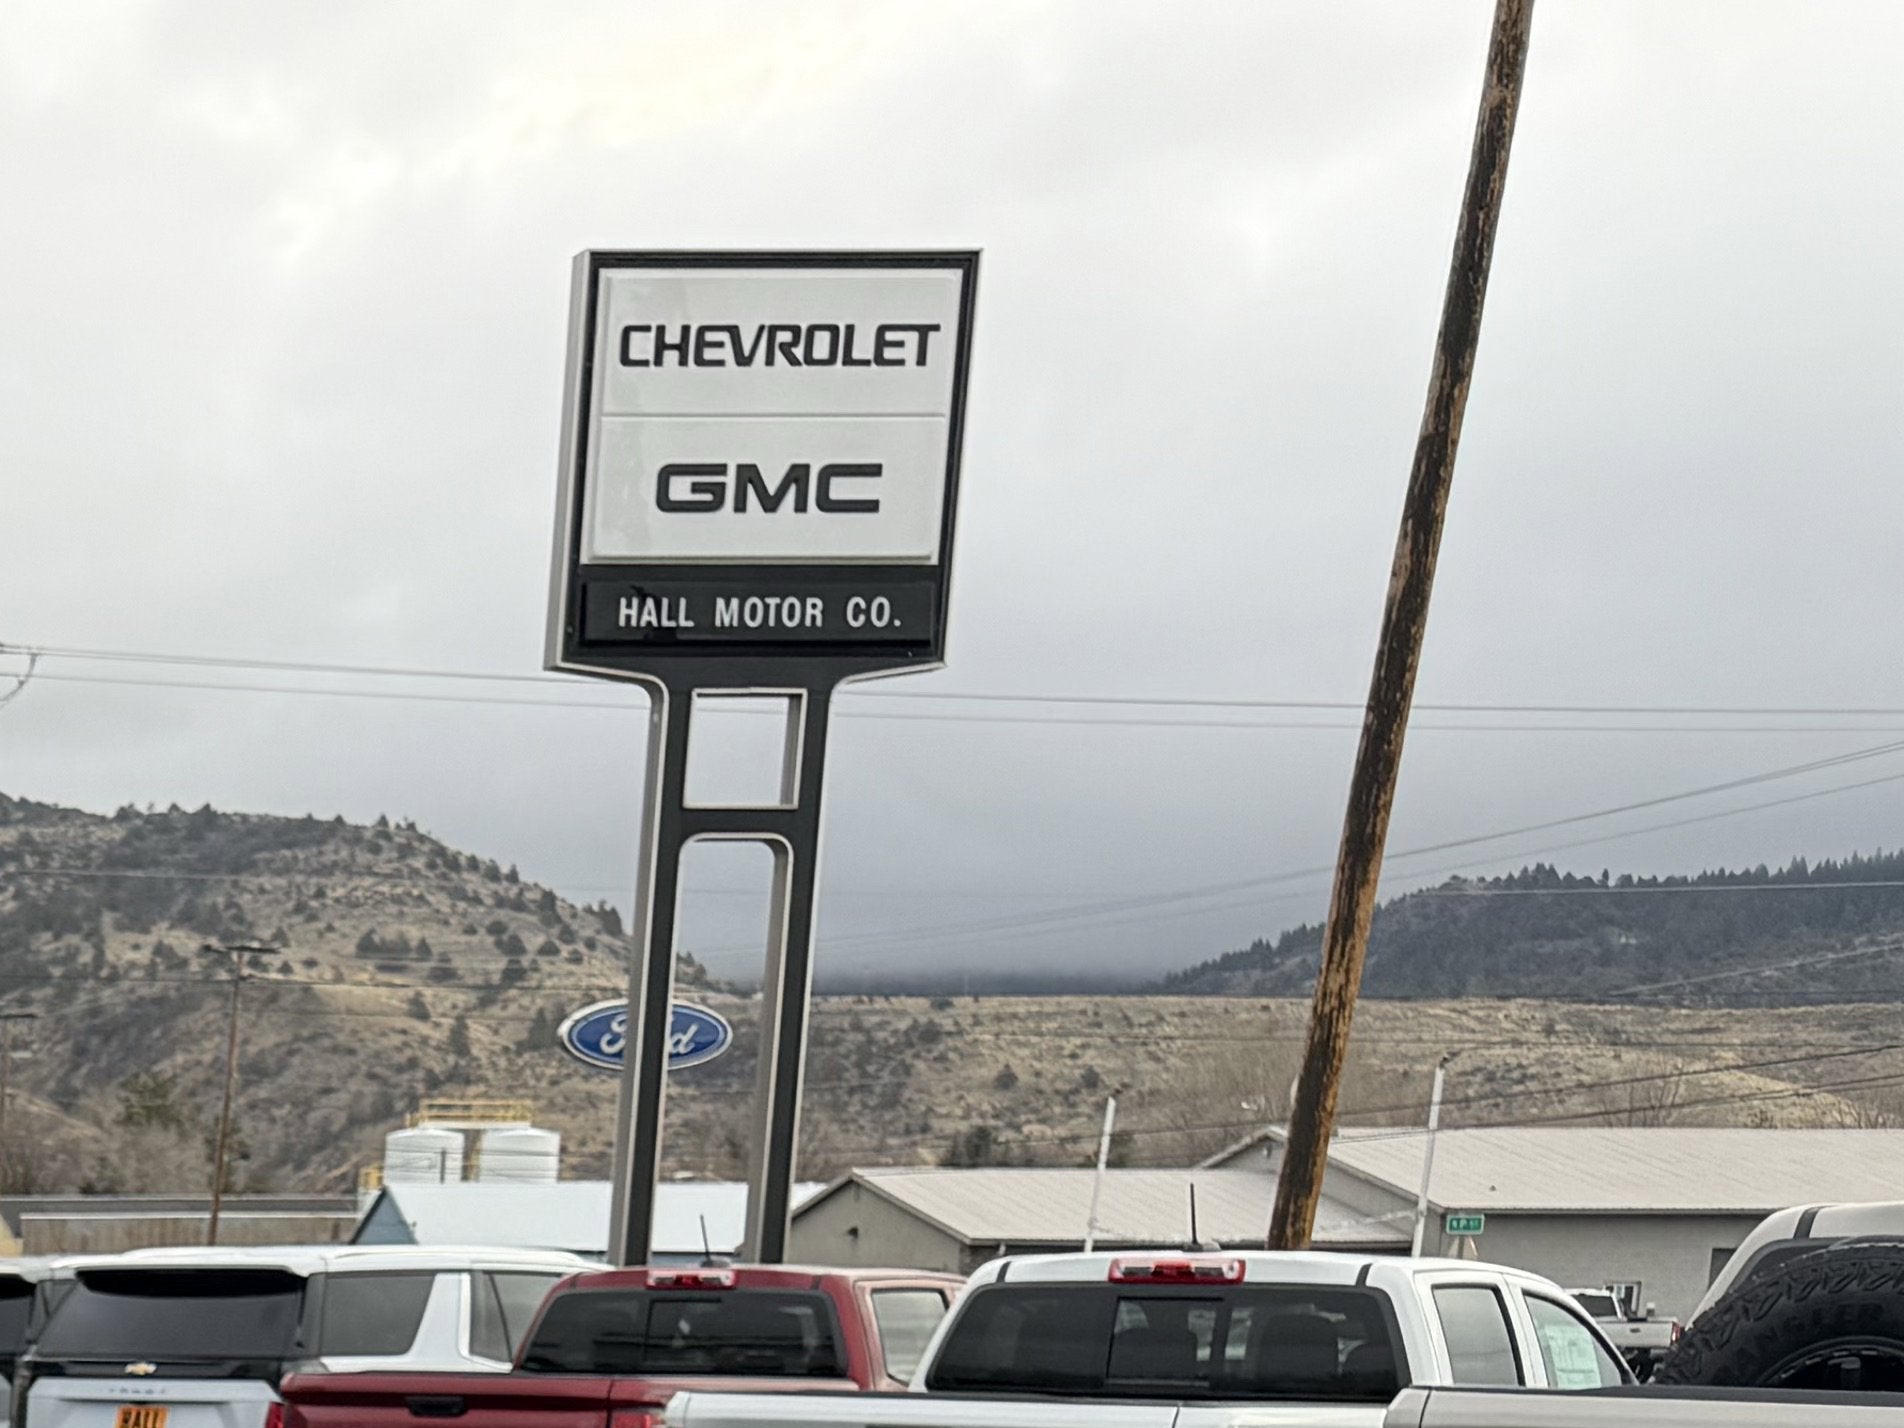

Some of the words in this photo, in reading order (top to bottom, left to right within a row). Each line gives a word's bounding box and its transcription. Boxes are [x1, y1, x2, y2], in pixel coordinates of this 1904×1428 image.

[618, 322, 942, 368] CHEVROLET
[655, 462, 883, 514] GMC
[618, 596, 695, 628] HALL
[714, 596, 824, 628] MOTOR
[845, 596, 903, 628] CO.
